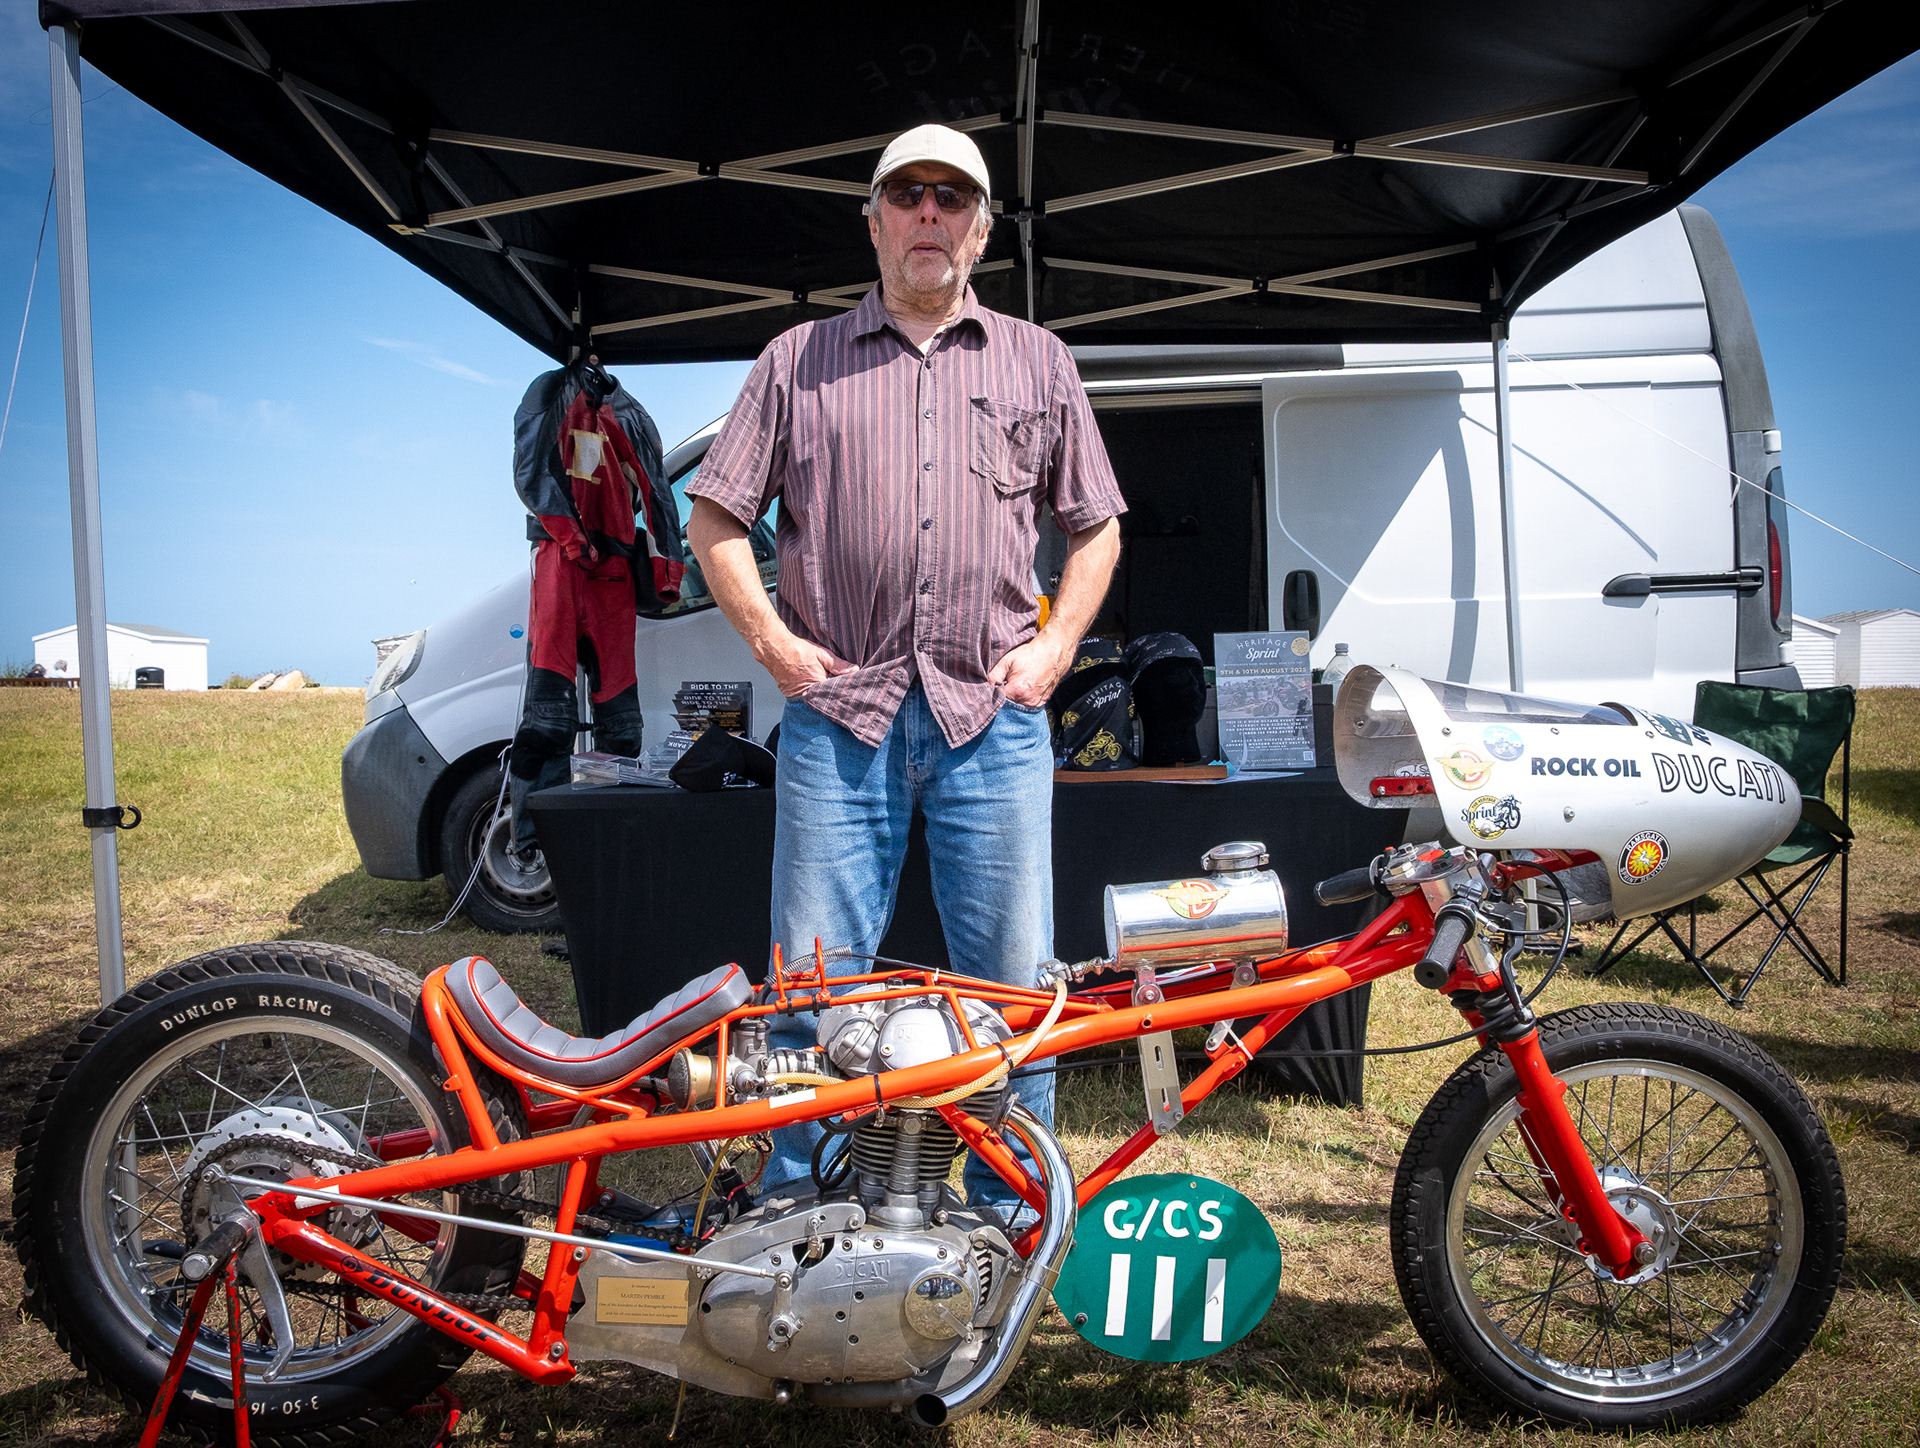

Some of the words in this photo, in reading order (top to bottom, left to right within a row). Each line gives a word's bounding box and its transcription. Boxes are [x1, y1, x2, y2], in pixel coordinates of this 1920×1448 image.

[1236, 638, 1288, 649] HERITAGE
[1246, 648, 1280, 661] Sprint
[1085, 681, 1125, 704] HERITAG
[667, 741, 687, 749] PARK
[1531, 757, 1599, 777] ROCK
[1604, 758, 1641, 778] OIL
[1651, 752, 1787, 803] DUCATI
[1461, 806, 1497, 824] Sprint
[1626, 832, 1664, 851] RAMSGATE
[1620, 867, 1638, 883] SPRINT
[1641, 857, 1669, 882] REVIVAL
[160, 997, 238, 1031] DUNLOP
[258, 995, 332, 1016] RACING
[1103, 1197, 1223, 1242] G/CS
[833, 1259, 891, 1279] DUCATI
[363, 1269, 503, 1342] DUNLOP
[1104, 1253, 1227, 1343] 111
[251, 1402, 266, 1415] 16
